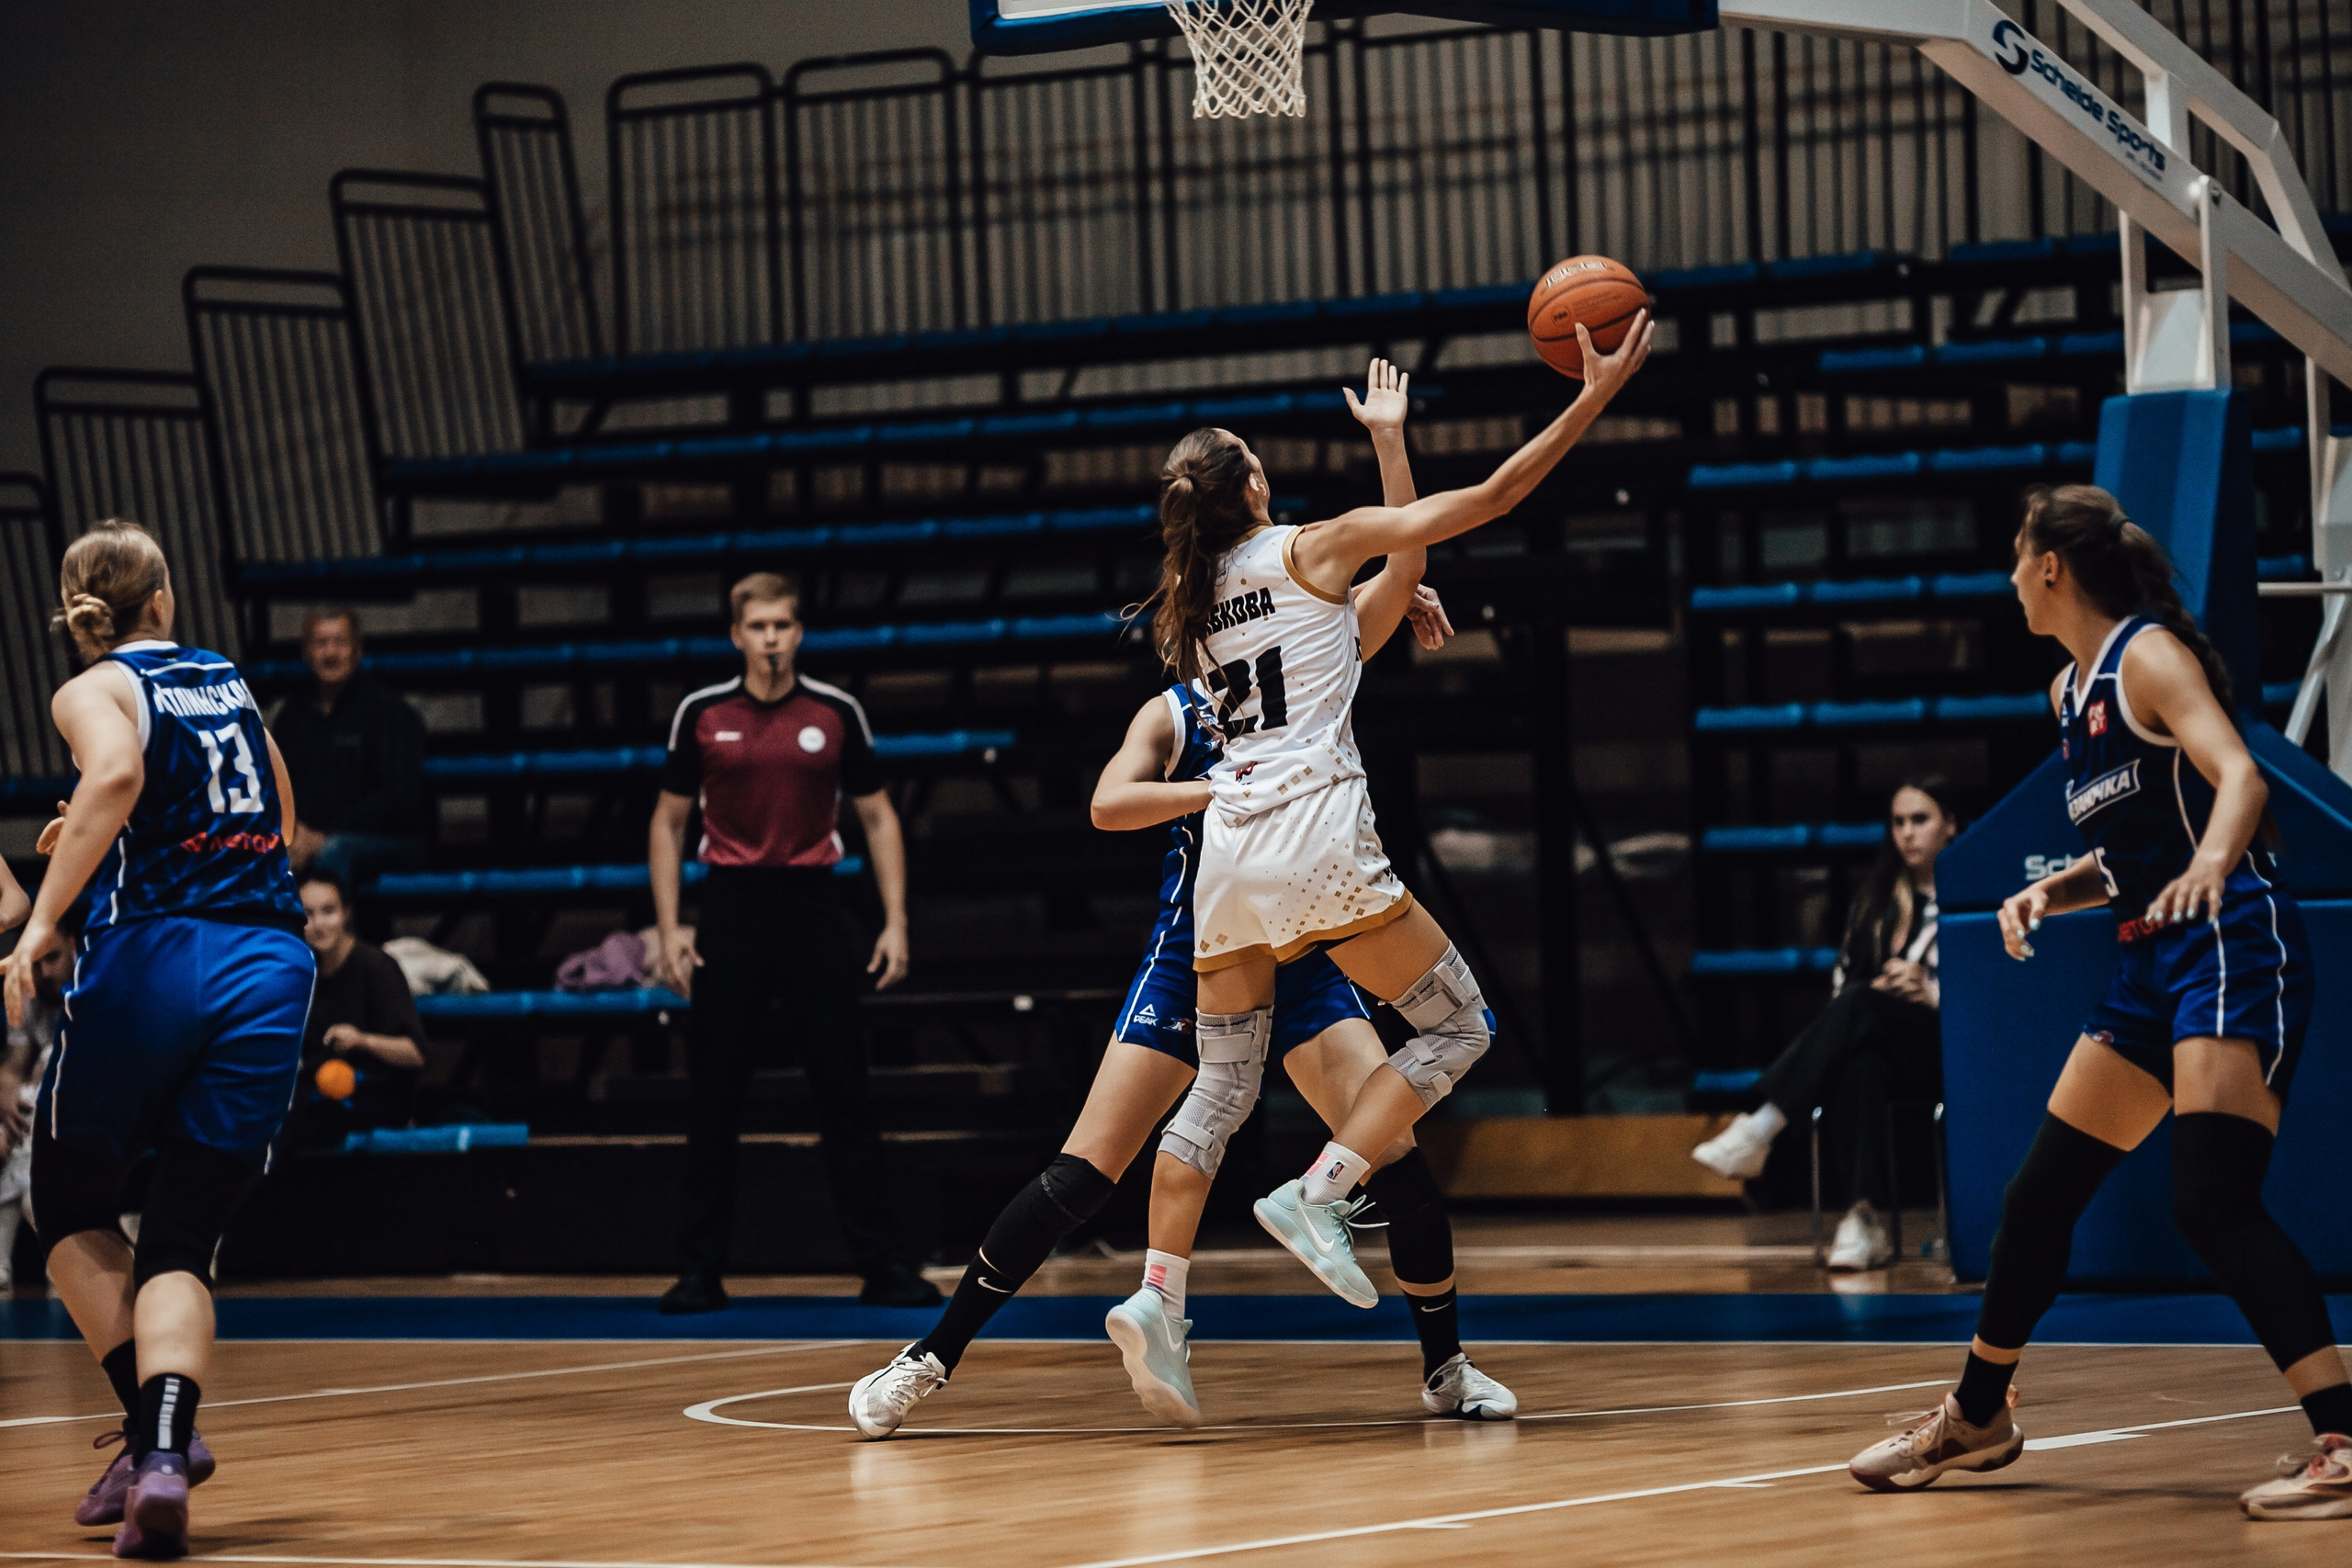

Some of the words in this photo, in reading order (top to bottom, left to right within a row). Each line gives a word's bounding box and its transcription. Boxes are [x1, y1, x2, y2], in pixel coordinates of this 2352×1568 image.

[2106, 109, 2166, 172] Sports
[1205, 586, 1276, 636] БКОВА
[1206, 645, 1289, 744] 21
[197, 722, 265, 814] 13
[1134, 1015, 1159, 1026] PEAK
